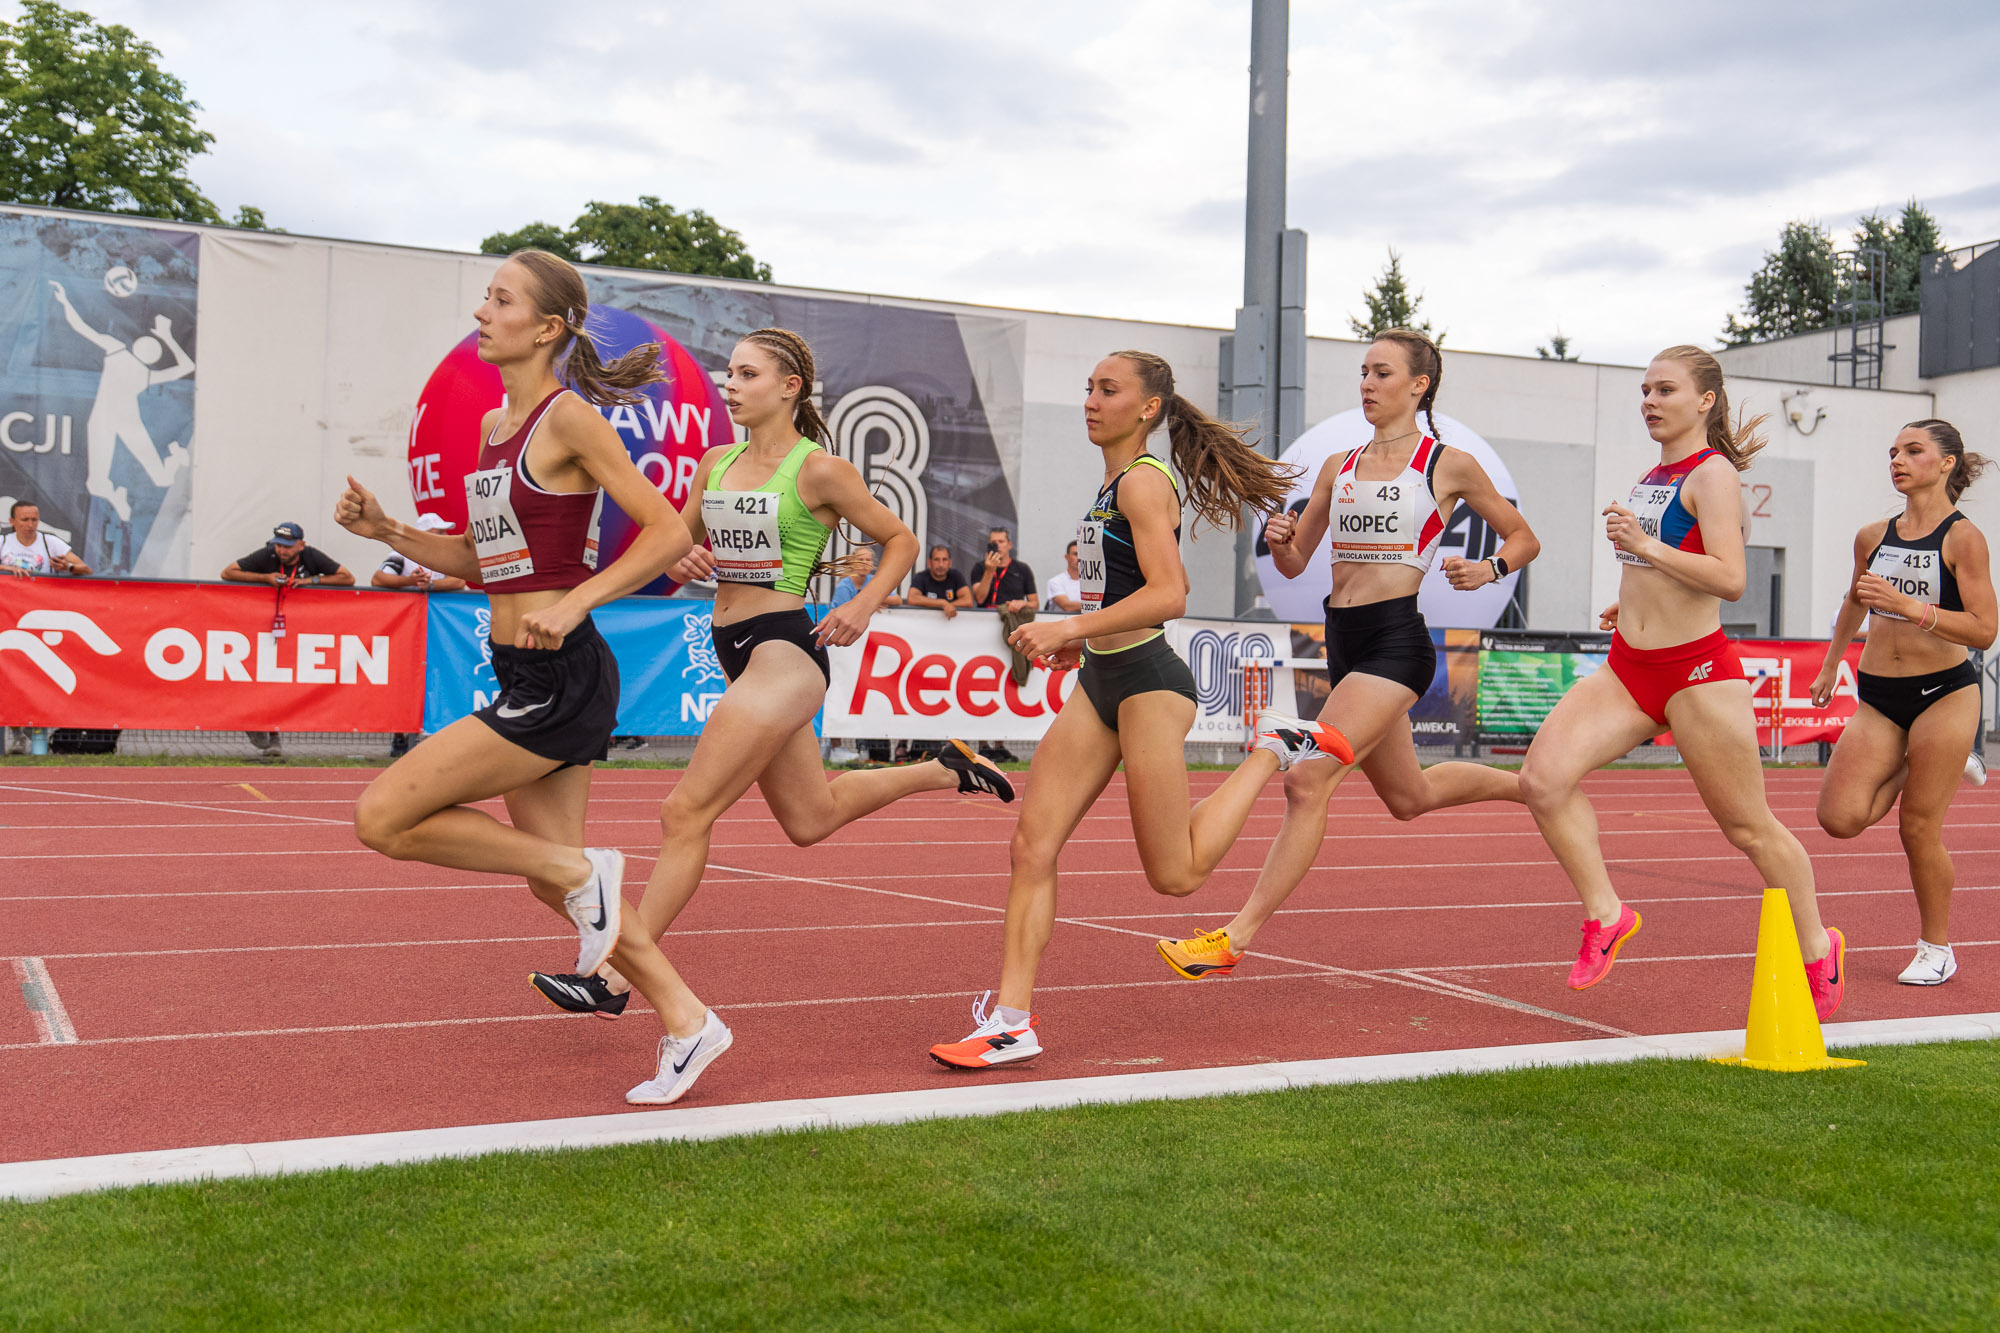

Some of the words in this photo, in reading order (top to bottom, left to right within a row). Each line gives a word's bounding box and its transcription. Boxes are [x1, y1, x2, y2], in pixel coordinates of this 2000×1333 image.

[593, 398, 711, 448] AWY
[0, 411, 72, 455] CJI
[475, 475, 502, 499] 407
[1376, 486, 1401, 502] 43
[734, 496, 768, 515] 421
[1648, 489, 1670, 505] 595
[1339, 511, 1399, 533] KOPEĆ
[707, 527, 771, 553] ARĘBA
[1080, 526, 1096, 545] 12
[1337, 552, 1380, 560] WŁOCŁAWEK
[1903, 553, 1931, 569] 413
[500, 564, 521, 577] 2025
[749, 571, 772, 579] 2025
[1877, 573, 1930, 596] ZIOR
[144, 627, 390, 686] ORLEN
[1687, 660, 1713, 682] 4F
[1190, 721, 1254, 731] ŁOCŁA
[1756, 716, 1778, 727] ZE
